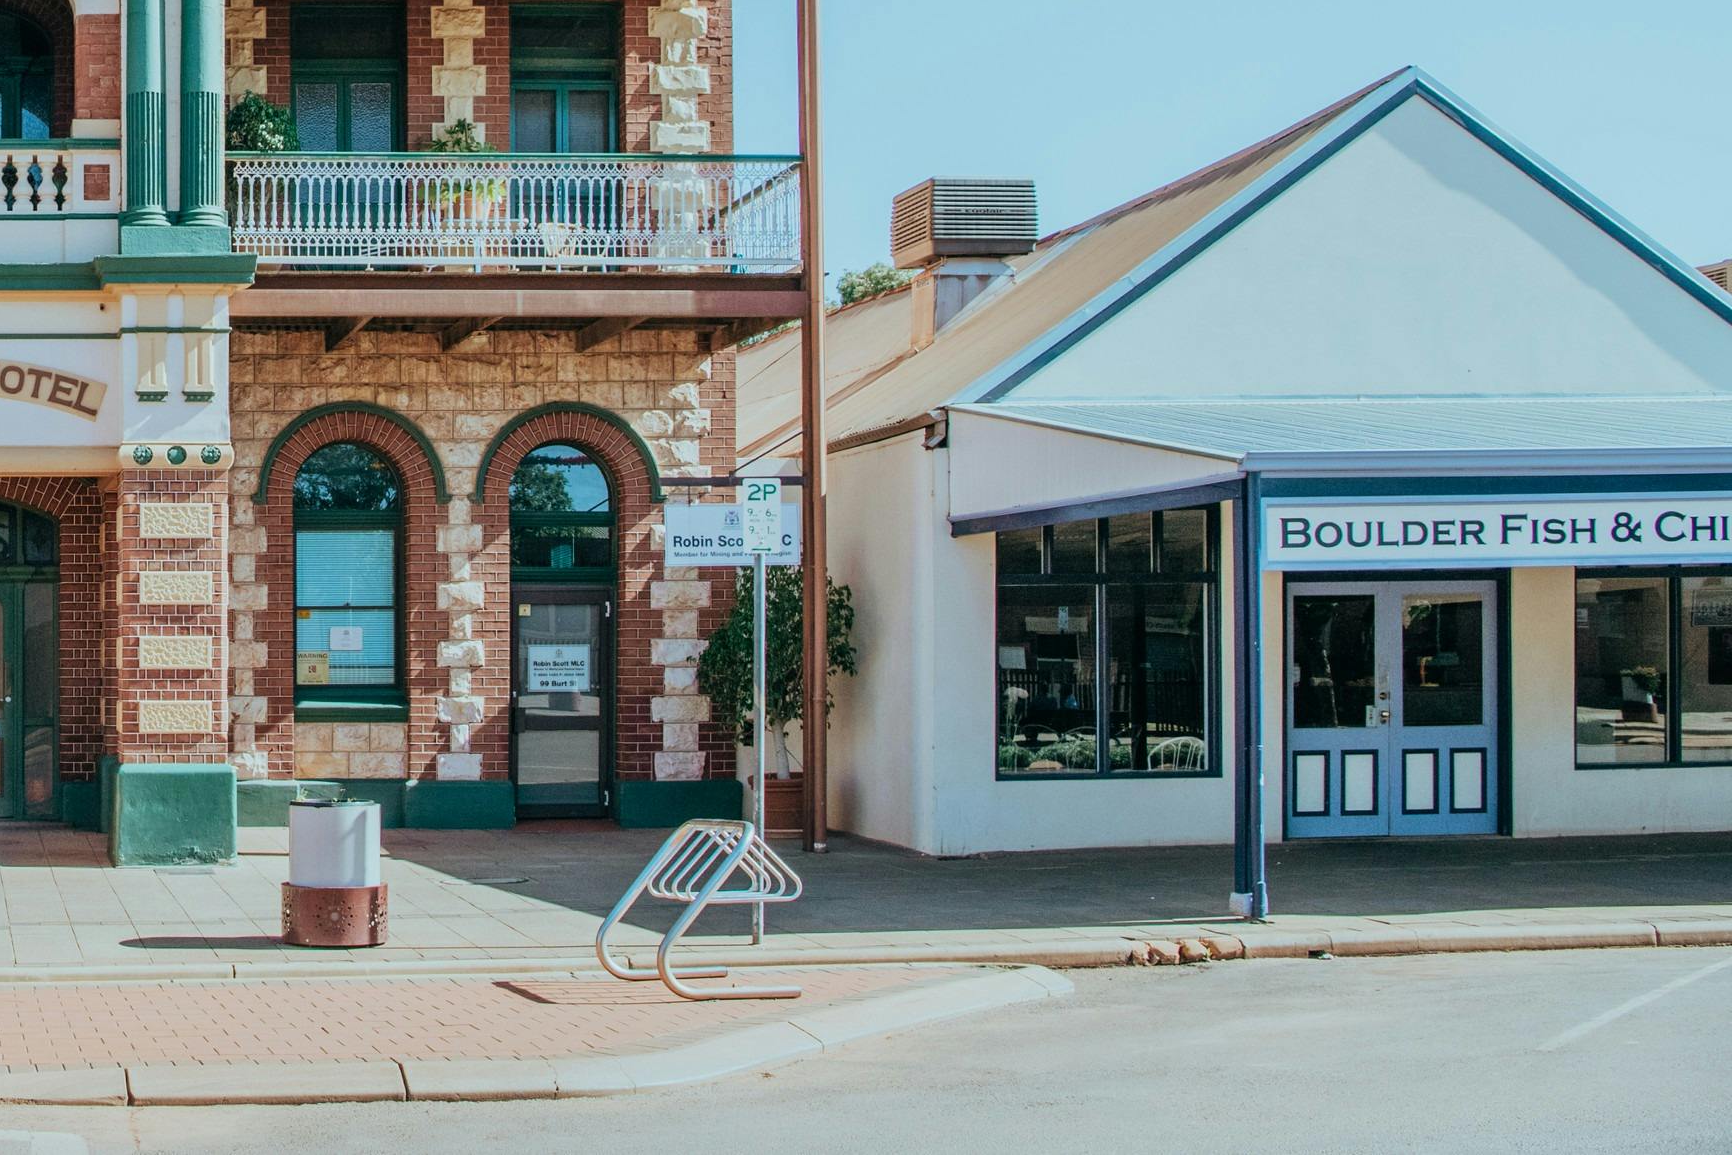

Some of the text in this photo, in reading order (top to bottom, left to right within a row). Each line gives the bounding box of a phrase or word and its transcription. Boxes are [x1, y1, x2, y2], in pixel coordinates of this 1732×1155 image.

[747, 483, 776, 501] 2P
[1279, 517, 1487, 549] BOULDER
[1499, 513, 1597, 545] FISH
[1610, 511, 1642, 543] &
[673, 535, 713, 548] Robin
[718, 535, 744, 548] Sco
[710, 551, 730, 559] Mining
